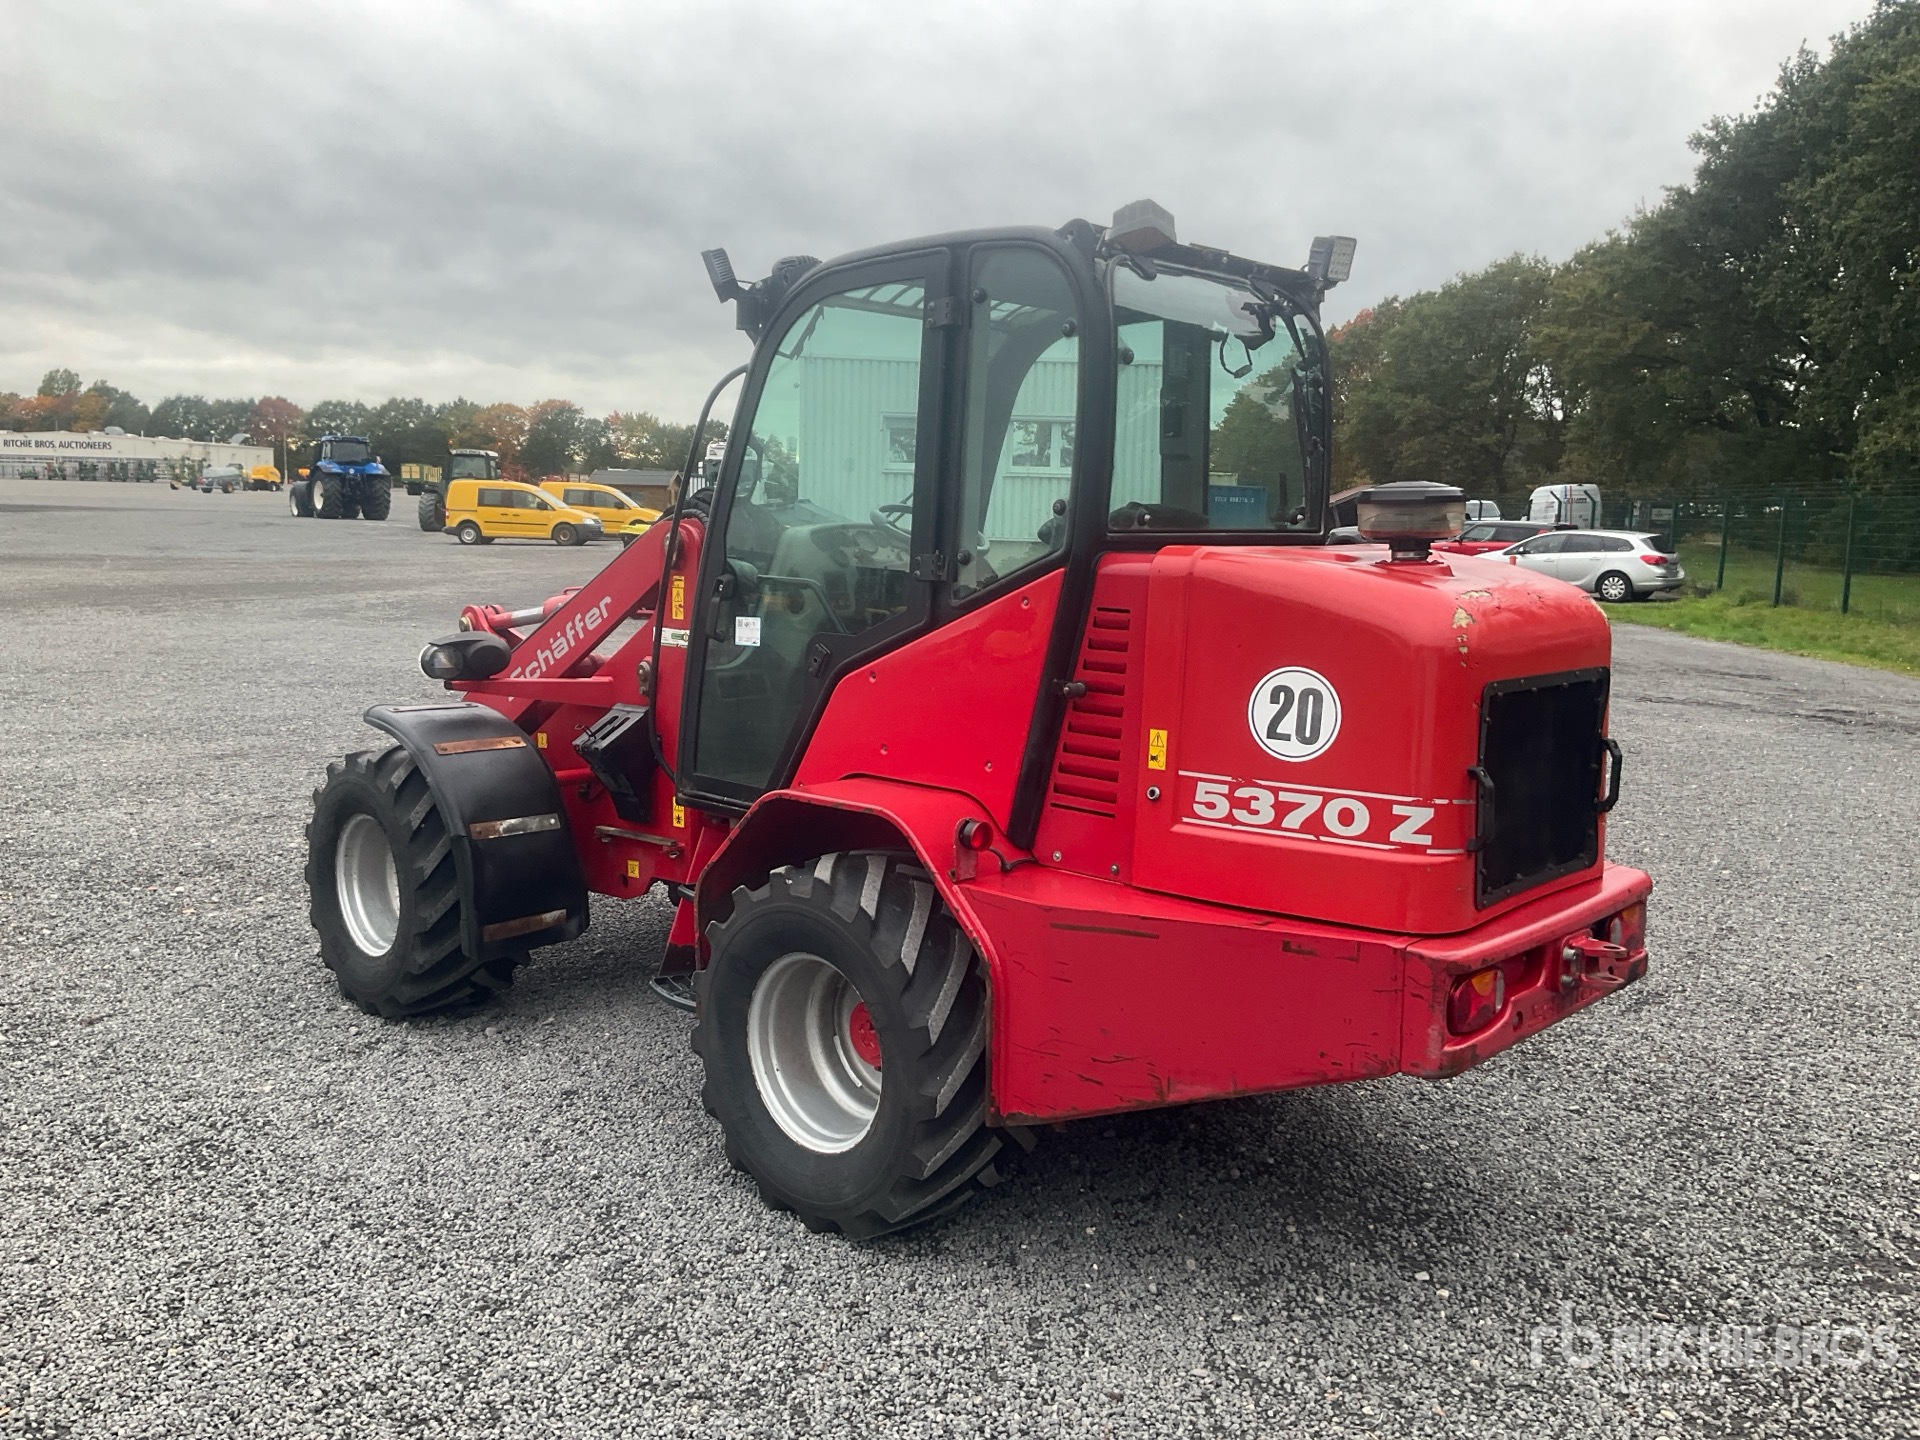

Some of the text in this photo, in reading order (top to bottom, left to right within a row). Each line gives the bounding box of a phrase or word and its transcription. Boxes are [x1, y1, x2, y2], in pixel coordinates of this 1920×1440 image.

[3, 439, 112, 450] RITCHIE BROS. AUCTIONEERS
[1266, 684, 1324, 746] 20
[1192, 781, 1435, 846] 5370 Z
